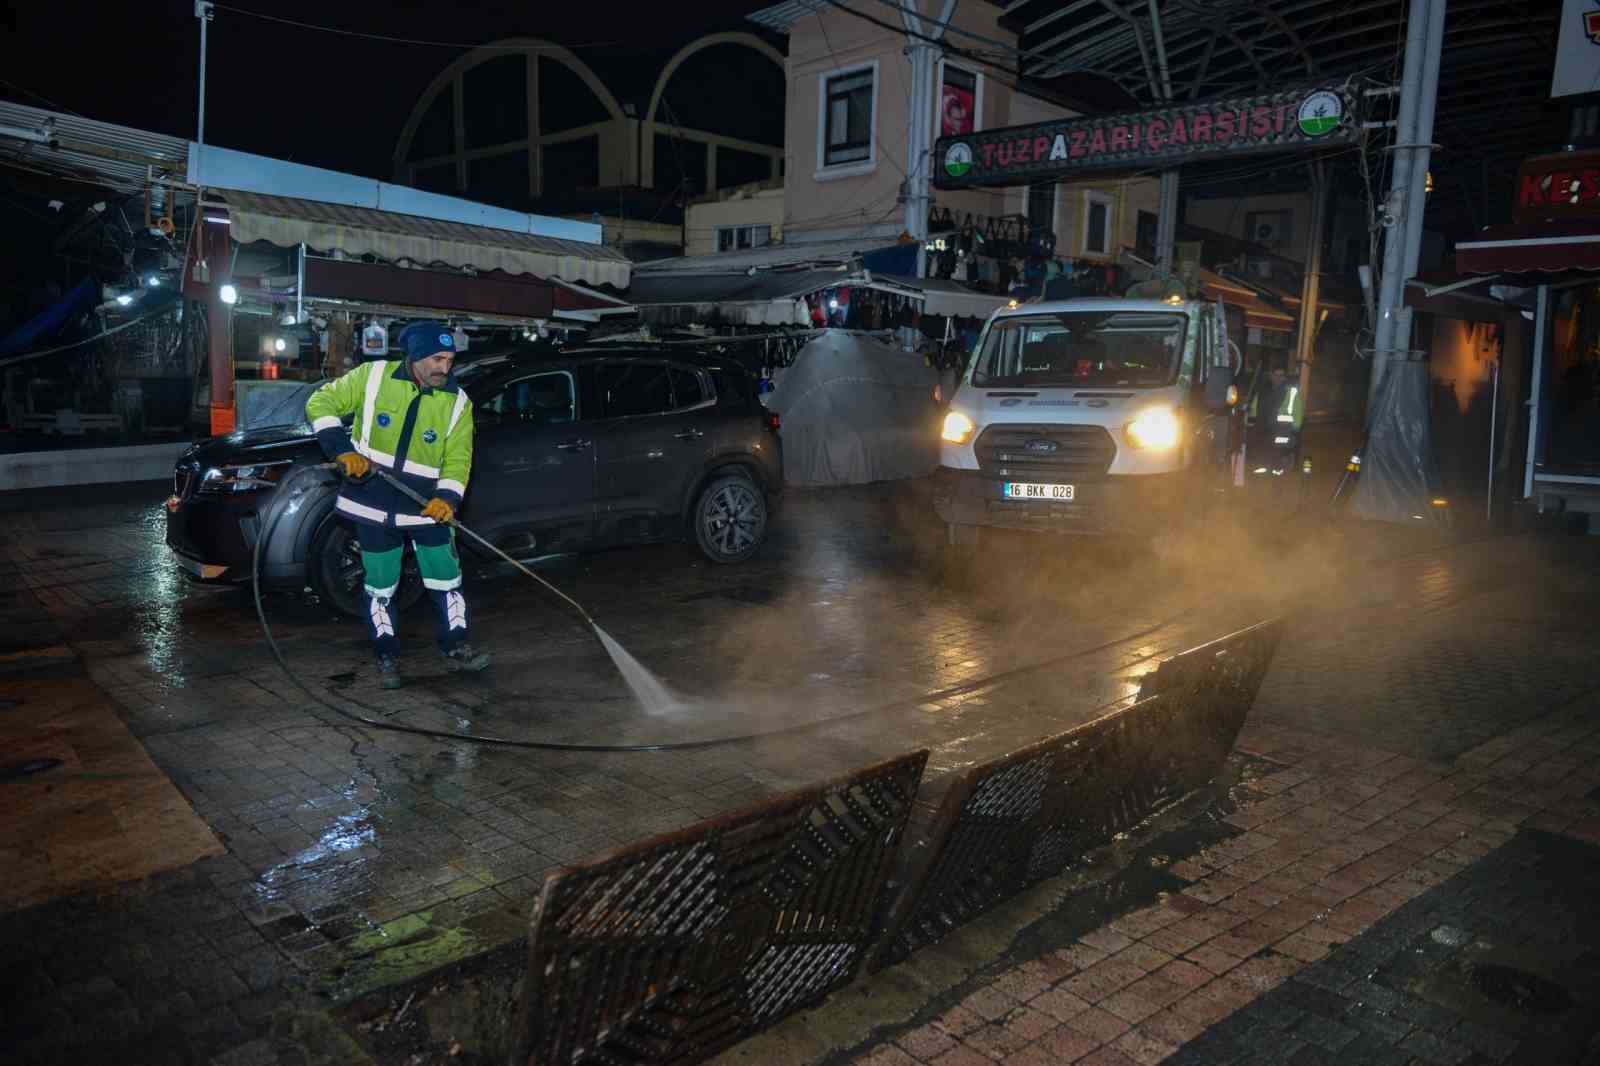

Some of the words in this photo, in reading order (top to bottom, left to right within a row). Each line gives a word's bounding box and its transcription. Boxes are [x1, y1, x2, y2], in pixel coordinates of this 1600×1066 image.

[1010, 485, 1020, 497] 16
[1026, 486, 1045, 497] BKK
[1053, 487, 1073, 498] 028
